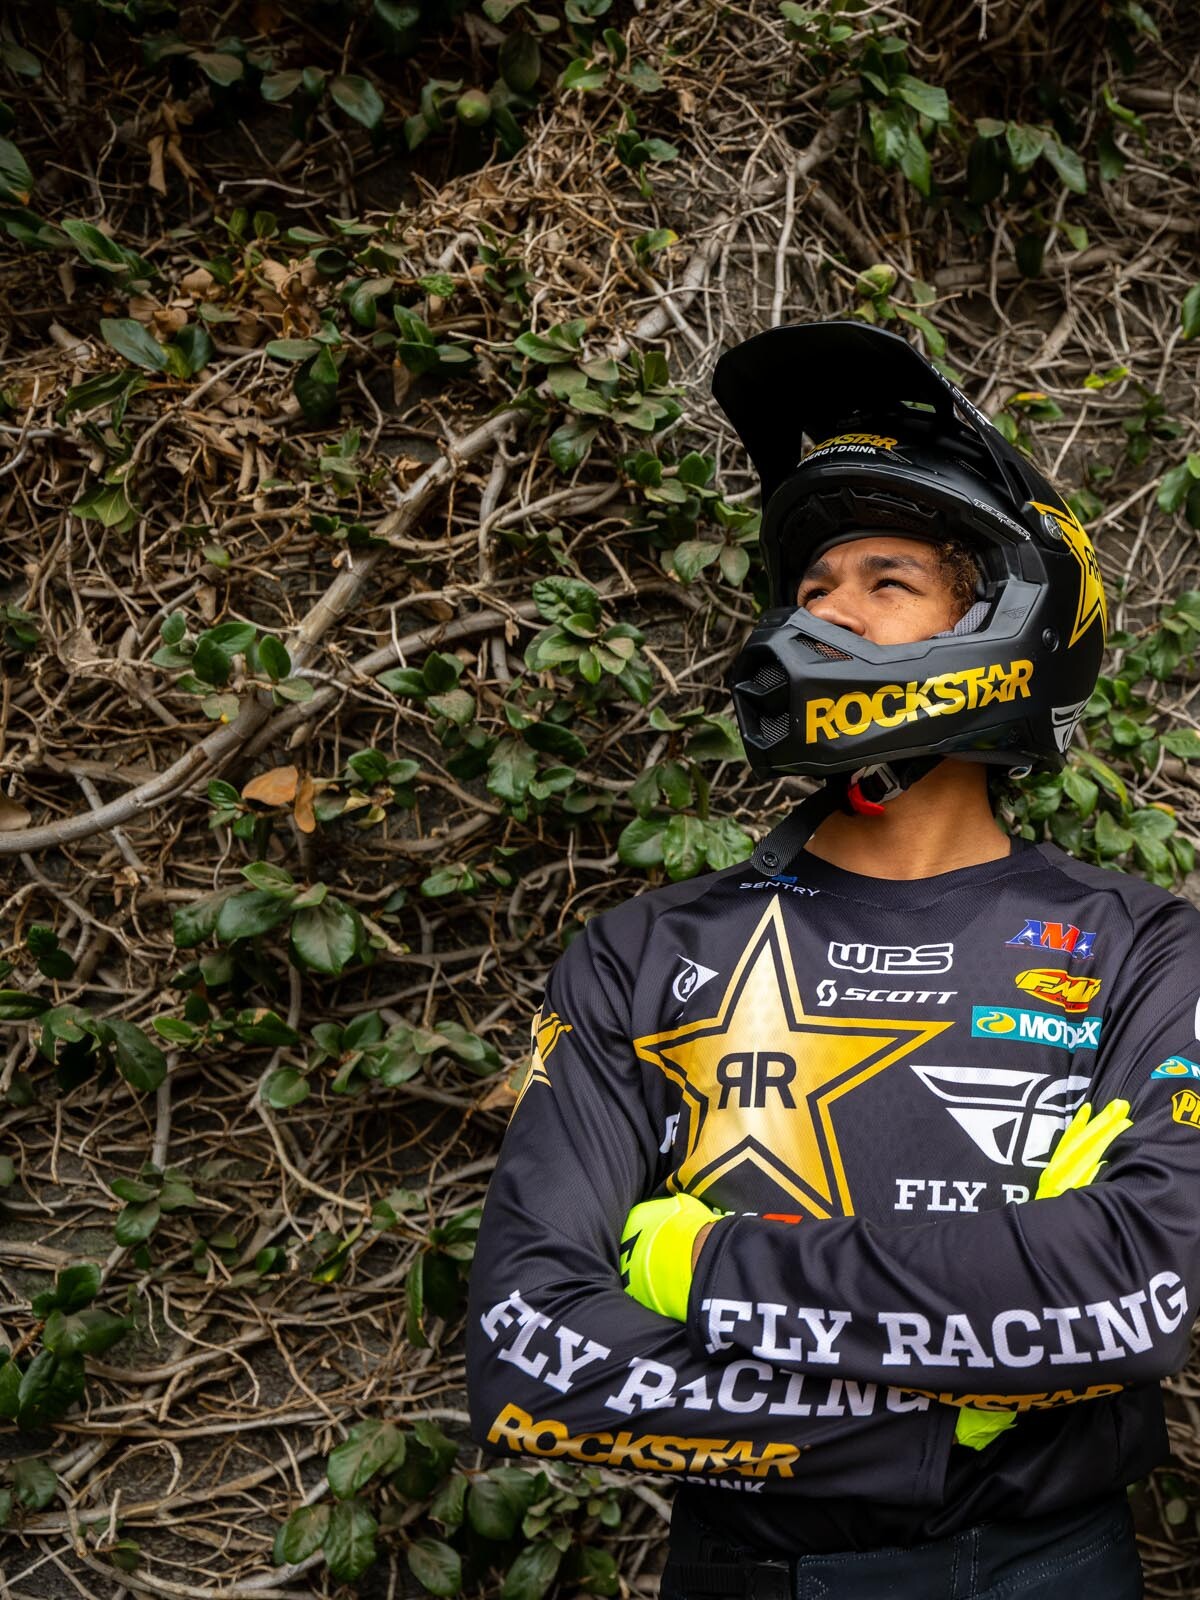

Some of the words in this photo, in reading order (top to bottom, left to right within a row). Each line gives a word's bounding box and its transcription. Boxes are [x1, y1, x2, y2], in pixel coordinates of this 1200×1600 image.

[837, 445, 877, 455] DRINK
[806, 659, 1034, 744] ROCKSTAR
[740, 881, 821, 897] SENTRY
[827, 941, 954, 975] WPS
[1004, 919, 1096, 960] AMA
[840, 987, 958, 1004] SCOTT
[894, 1178, 986, 1214] FLY
[702, 1298, 853, 1365] FLY
[878, 1270, 1187, 1369] RACING
[479, 1289, 612, 1395] FLY
[486, 1402, 801, 1479] ROCKSTAR
